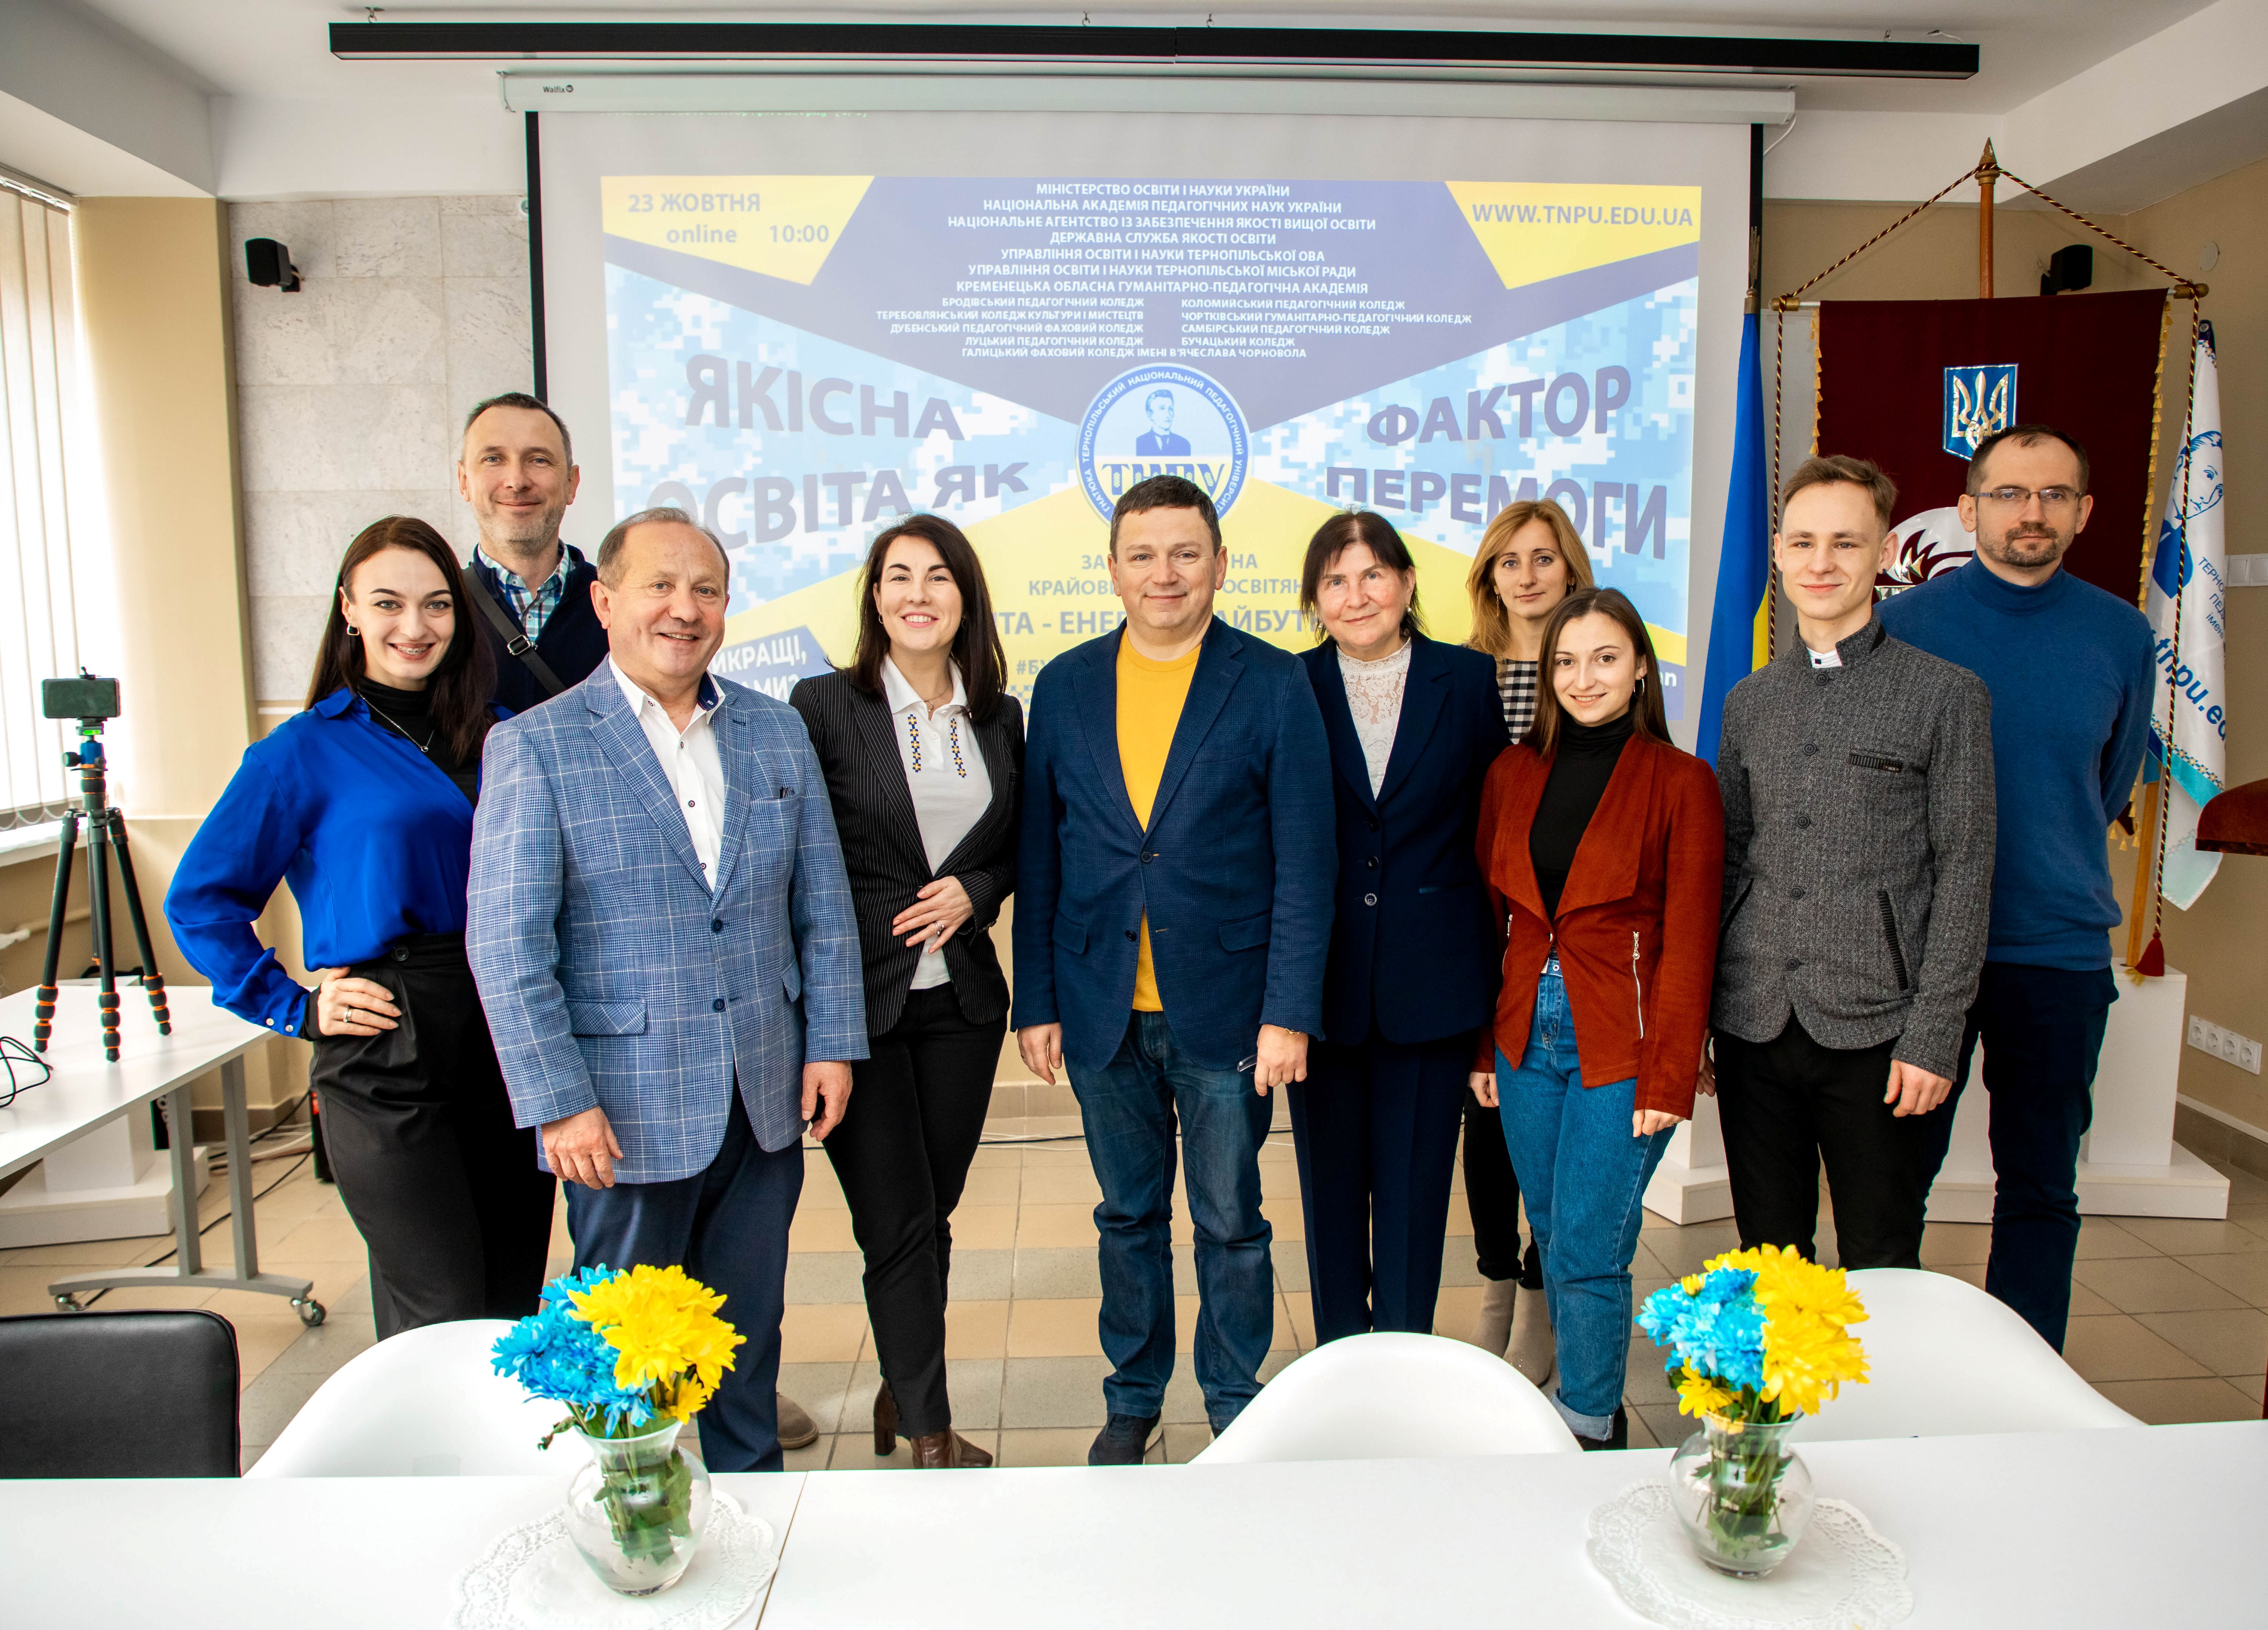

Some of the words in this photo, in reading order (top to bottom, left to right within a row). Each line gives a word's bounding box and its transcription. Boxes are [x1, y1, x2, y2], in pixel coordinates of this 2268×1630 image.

[1036, 183, 1130, 195] МІНІСТЕРСТВО
[1133, 184, 1180, 196] ОСВІТИ
[1189, 185, 1233, 196] НАУКИ
[1235, 184, 1290, 197] УКРАЇНИ
[628, 193, 654, 213] 23
[661, 193, 761, 213] ЖОВТНЯ
[983, 199, 1079, 213] НАЦІОНАЛЬНА
[1082, 199, 1149, 213] АКАДЕМІЯ
[1151, 200, 1249, 214] ПЕДАГОГІЧНИХ
[1251, 201, 1285, 213] НАУК
[1287, 201, 1342, 213] УКРАЇНИ
[1472, 203, 1693, 226] WWW.TNPU.EDU.UA
[948, 216, 1043, 229] НАЦІОНАЛЬНЕ
[1045, 216, 1119, 228] АГЕНТСТВО
[1121, 216, 1133, 228] ІЗ
[1135, 216, 1234, 228] ЗАБЕЗПЕЧЕННЯ
[1236, 217, 1282, 229] ЯКОСТІ
[1284, 217, 1328, 232] ВИЩОЇ
[1329, 219, 1376, 230] ОСВІТИ
[666, 224, 737, 243] online
[769, 225, 829, 243] 10:00
[1050, 231, 1122, 245] ДЕРЖАВНА
[1125, 232, 1179, 244] СЛУЖБА
[1182, 232, 1227, 244] ЯКОСТІ
[1230, 232, 1276, 245] ОСВІТИ
[1001, 248, 1082, 260] УПРАВЛІННЯ
[1084, 248, 1132, 260] ОСВІТИ
[1141, 249, 1184, 260] НАУКИ
[1187, 249, 1297, 261] ТЕРНОПІЛЬСЬКОЇ
[1298, 250, 1325, 262] ОВА
[968, 264, 1050, 276] УПРАВЛІННЯ
[1053, 264, 1100, 276] ОСВІТИ
[1109, 264, 1152, 276] НАУКИ
[1155, 264, 1265, 277] ТЕРНОПІЛЬСЬКОЇ
[1267, 264, 1321, 277] МІСЬКОЇ
[1322, 266, 1356, 280] РАДИ
[956, 281, 1051, 294] КРЕМЕНЕЦЬКА
[1053, 281, 1116, 292] ОБЛАСНА
[1118, 281, 1301, 295] ГУМАНІТАРНО-ПЕДАГОГІЧНА
[1302, 282, 1368, 296] АКАДЕМІЯ
[942, 297, 1015, 308] БРОДІВСЬКИЙ
[1017, 297, 1097, 308] ПЕДАГОГІЧНИЙ
[1100, 297, 1144, 308] КОЛЕДЖ
[1181, 299, 1273, 309] КОЛОМИЙСЬКИЙ
[1275, 299, 1357, 310] ПЕДАГОГІЧНИЙ
[1359, 300, 1406, 311] КОЛЕДЖ
[875, 310, 979, 320] ТЕРЕБОВЛЯНСЬКИЙ
[981, 310, 1027, 321] КОЛЕДЖ
[1028, 310, 1081, 320] КУЛЬТУРИ
[1088, 310, 1144, 322] МИСТЕЦТВ
[1181, 312, 1263, 322] ЧОРТКІВСЬКИЙ
[1264, 312, 1425, 324] ГУМАНІТАРНО-ПЕДАГОГІЧНИЙ
[1426, 314, 1472, 325] КОЛЕДЖ
[890, 322, 960, 335] ДУБЕНСЬКИЙ
[962, 322, 1043, 334] ПЕДАГОГІЧНИЙ
[1044, 322, 1097, 333] ФАХОВИЙ
[1098, 323, 1144, 335] КОЛЕДЖ
[1181, 323, 1259, 333] САМБІРСЬКИЙ
[1260, 324, 1342, 335] ПЕДАГОГІЧНИЙ
[1344, 325, 1391, 336] КОЛЕДЖ
[965, 336, 1015, 347] ЛУЦЬКИЙ
[1017, 336, 1097, 347] ПЕДАГОГІЧНИЙ
[1099, 336, 1143, 348] КОЛЕДЖ
[1181, 336, 1247, 348] БУЧАЦЬКИЙ
[1249, 337, 1296, 348] КОЛЕДЖ
[962, 348, 1028, 359] ГАЛИЦЬКИЙ
[1030, 347, 1085, 357] ФАХОВИЙ
[1087, 348, 1135, 359] КОЛЕДЖ
[1137, 348, 1167, 357] ІМЕНІ
[1238, 348, 1307, 358] ЧОРНОВОЛА
[1128, 371, 1204, 390] НАЦІОНАЛЬНИЙ
[685, 354, 965, 441] ЯКІСНА
[1366, 365, 1631, 446] ФАКТОР
[1082, 382, 1126, 463] ТЕРНОПІЛЬСЬКИЙ
[1205, 387, 1244, 455] ПЕДАГОГІЧНИЙ
[931, 461, 1029, 509] ЯК
[1084, 468, 1110, 512] ГНАТЮКА
[1216, 460, 1243, 513] УНІВЕРСИТ
